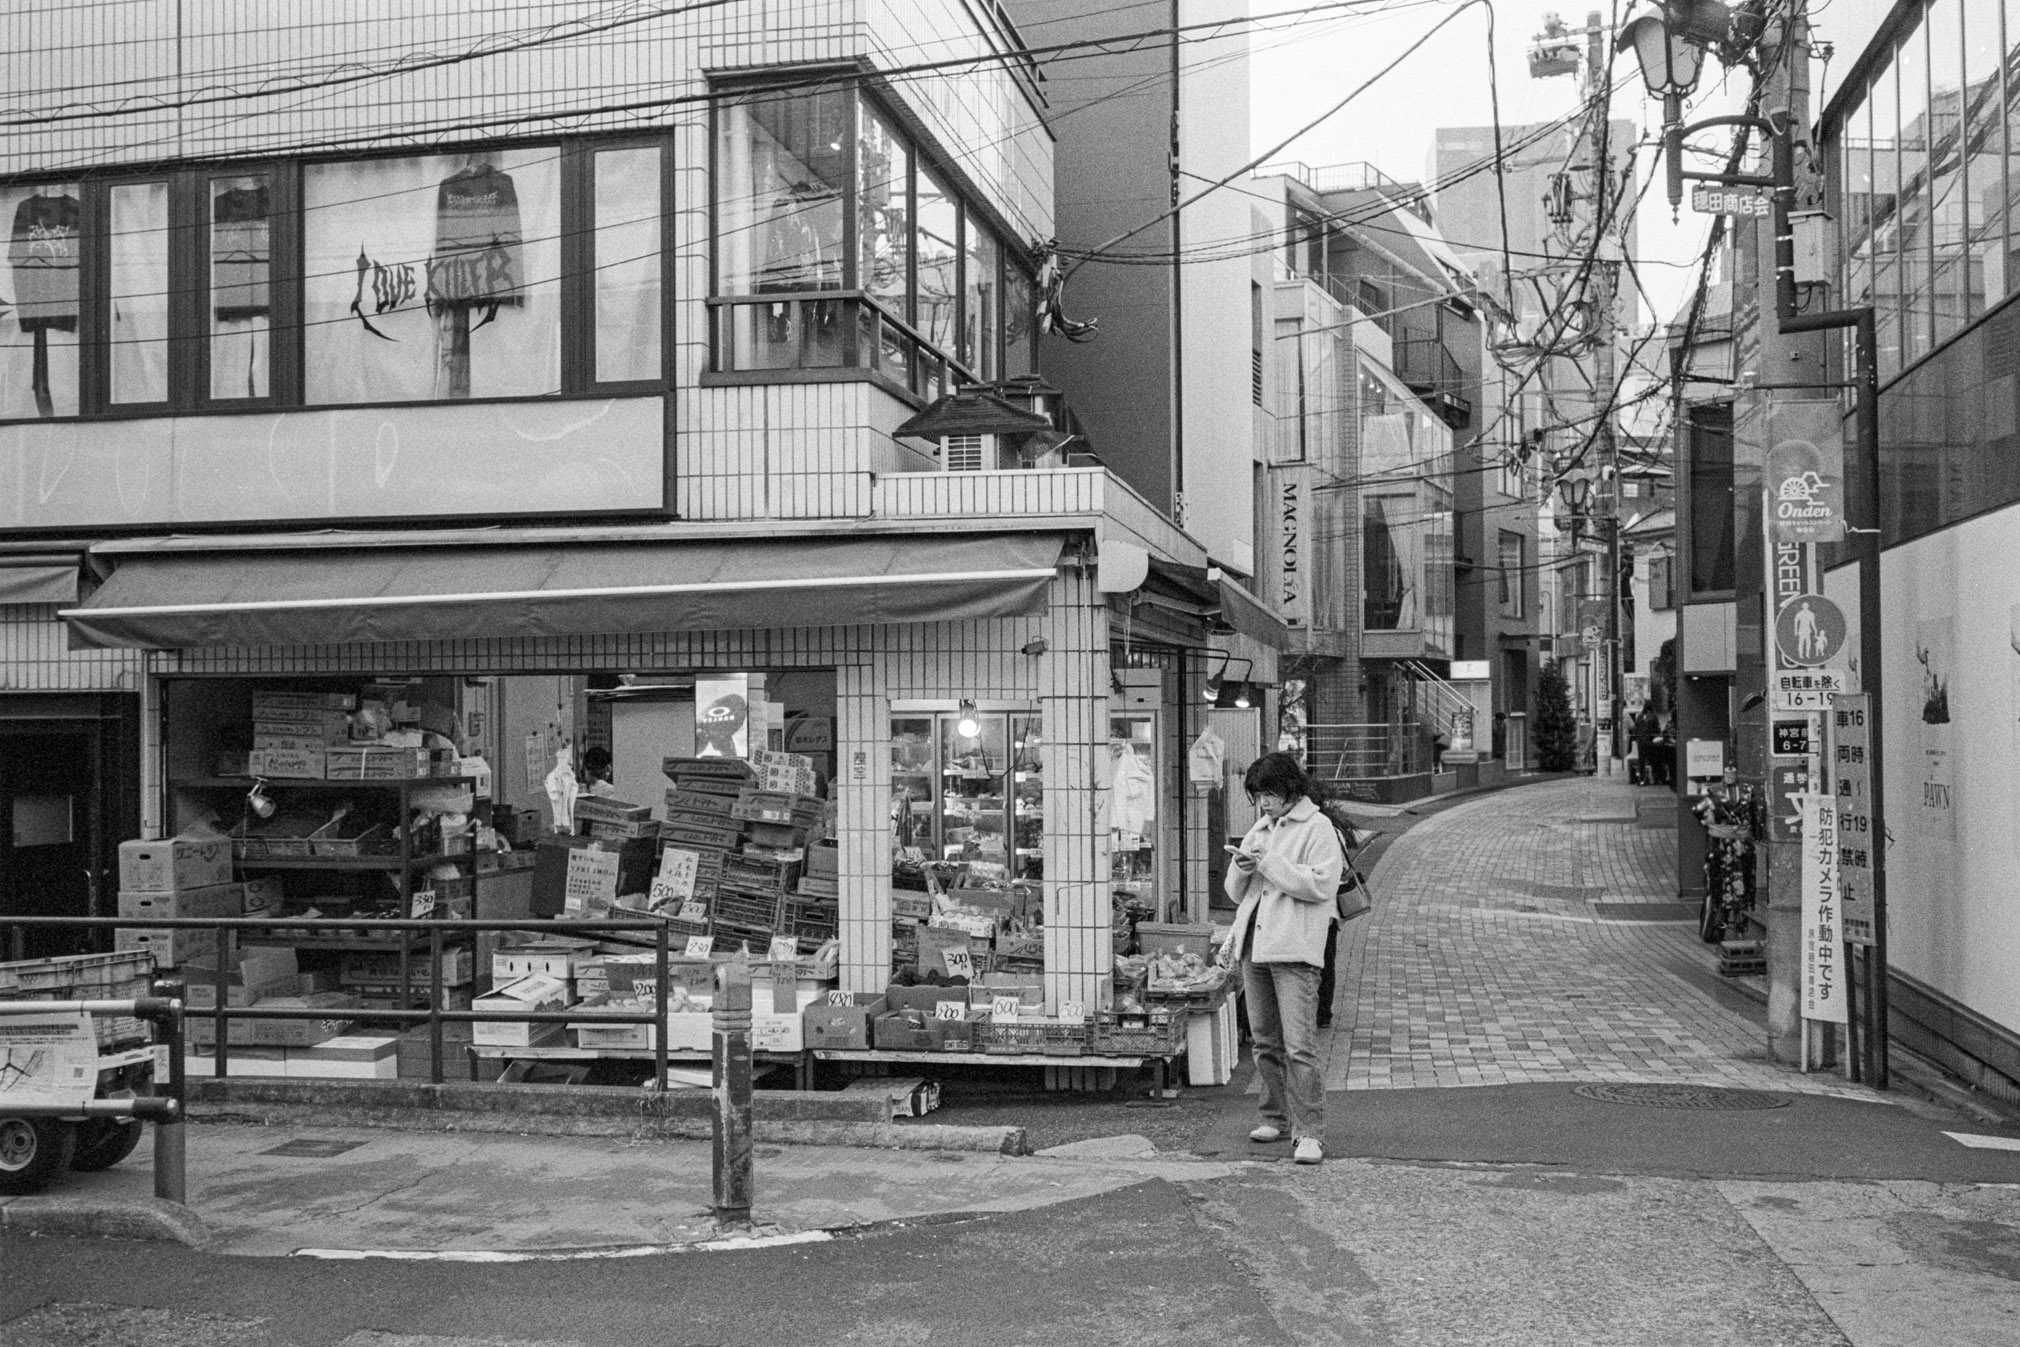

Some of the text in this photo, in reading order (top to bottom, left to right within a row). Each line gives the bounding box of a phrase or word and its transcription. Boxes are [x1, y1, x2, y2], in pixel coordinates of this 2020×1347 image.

[1693, 190, 1769, 216] 穏田商店会
[1778, 502, 1832, 519] Onden
[1283, 483, 1298, 604] MAGNOLIA
[1780, 676, 1840, 689] 自転車を除く
[1783, 772, 1808, 784] 通学
[1836, 710, 1857, 901] 車両通行禁止
[1818, 807, 1834, 1000] 防犯カメラ作動中です
[947, 952, 968, 967] 300
